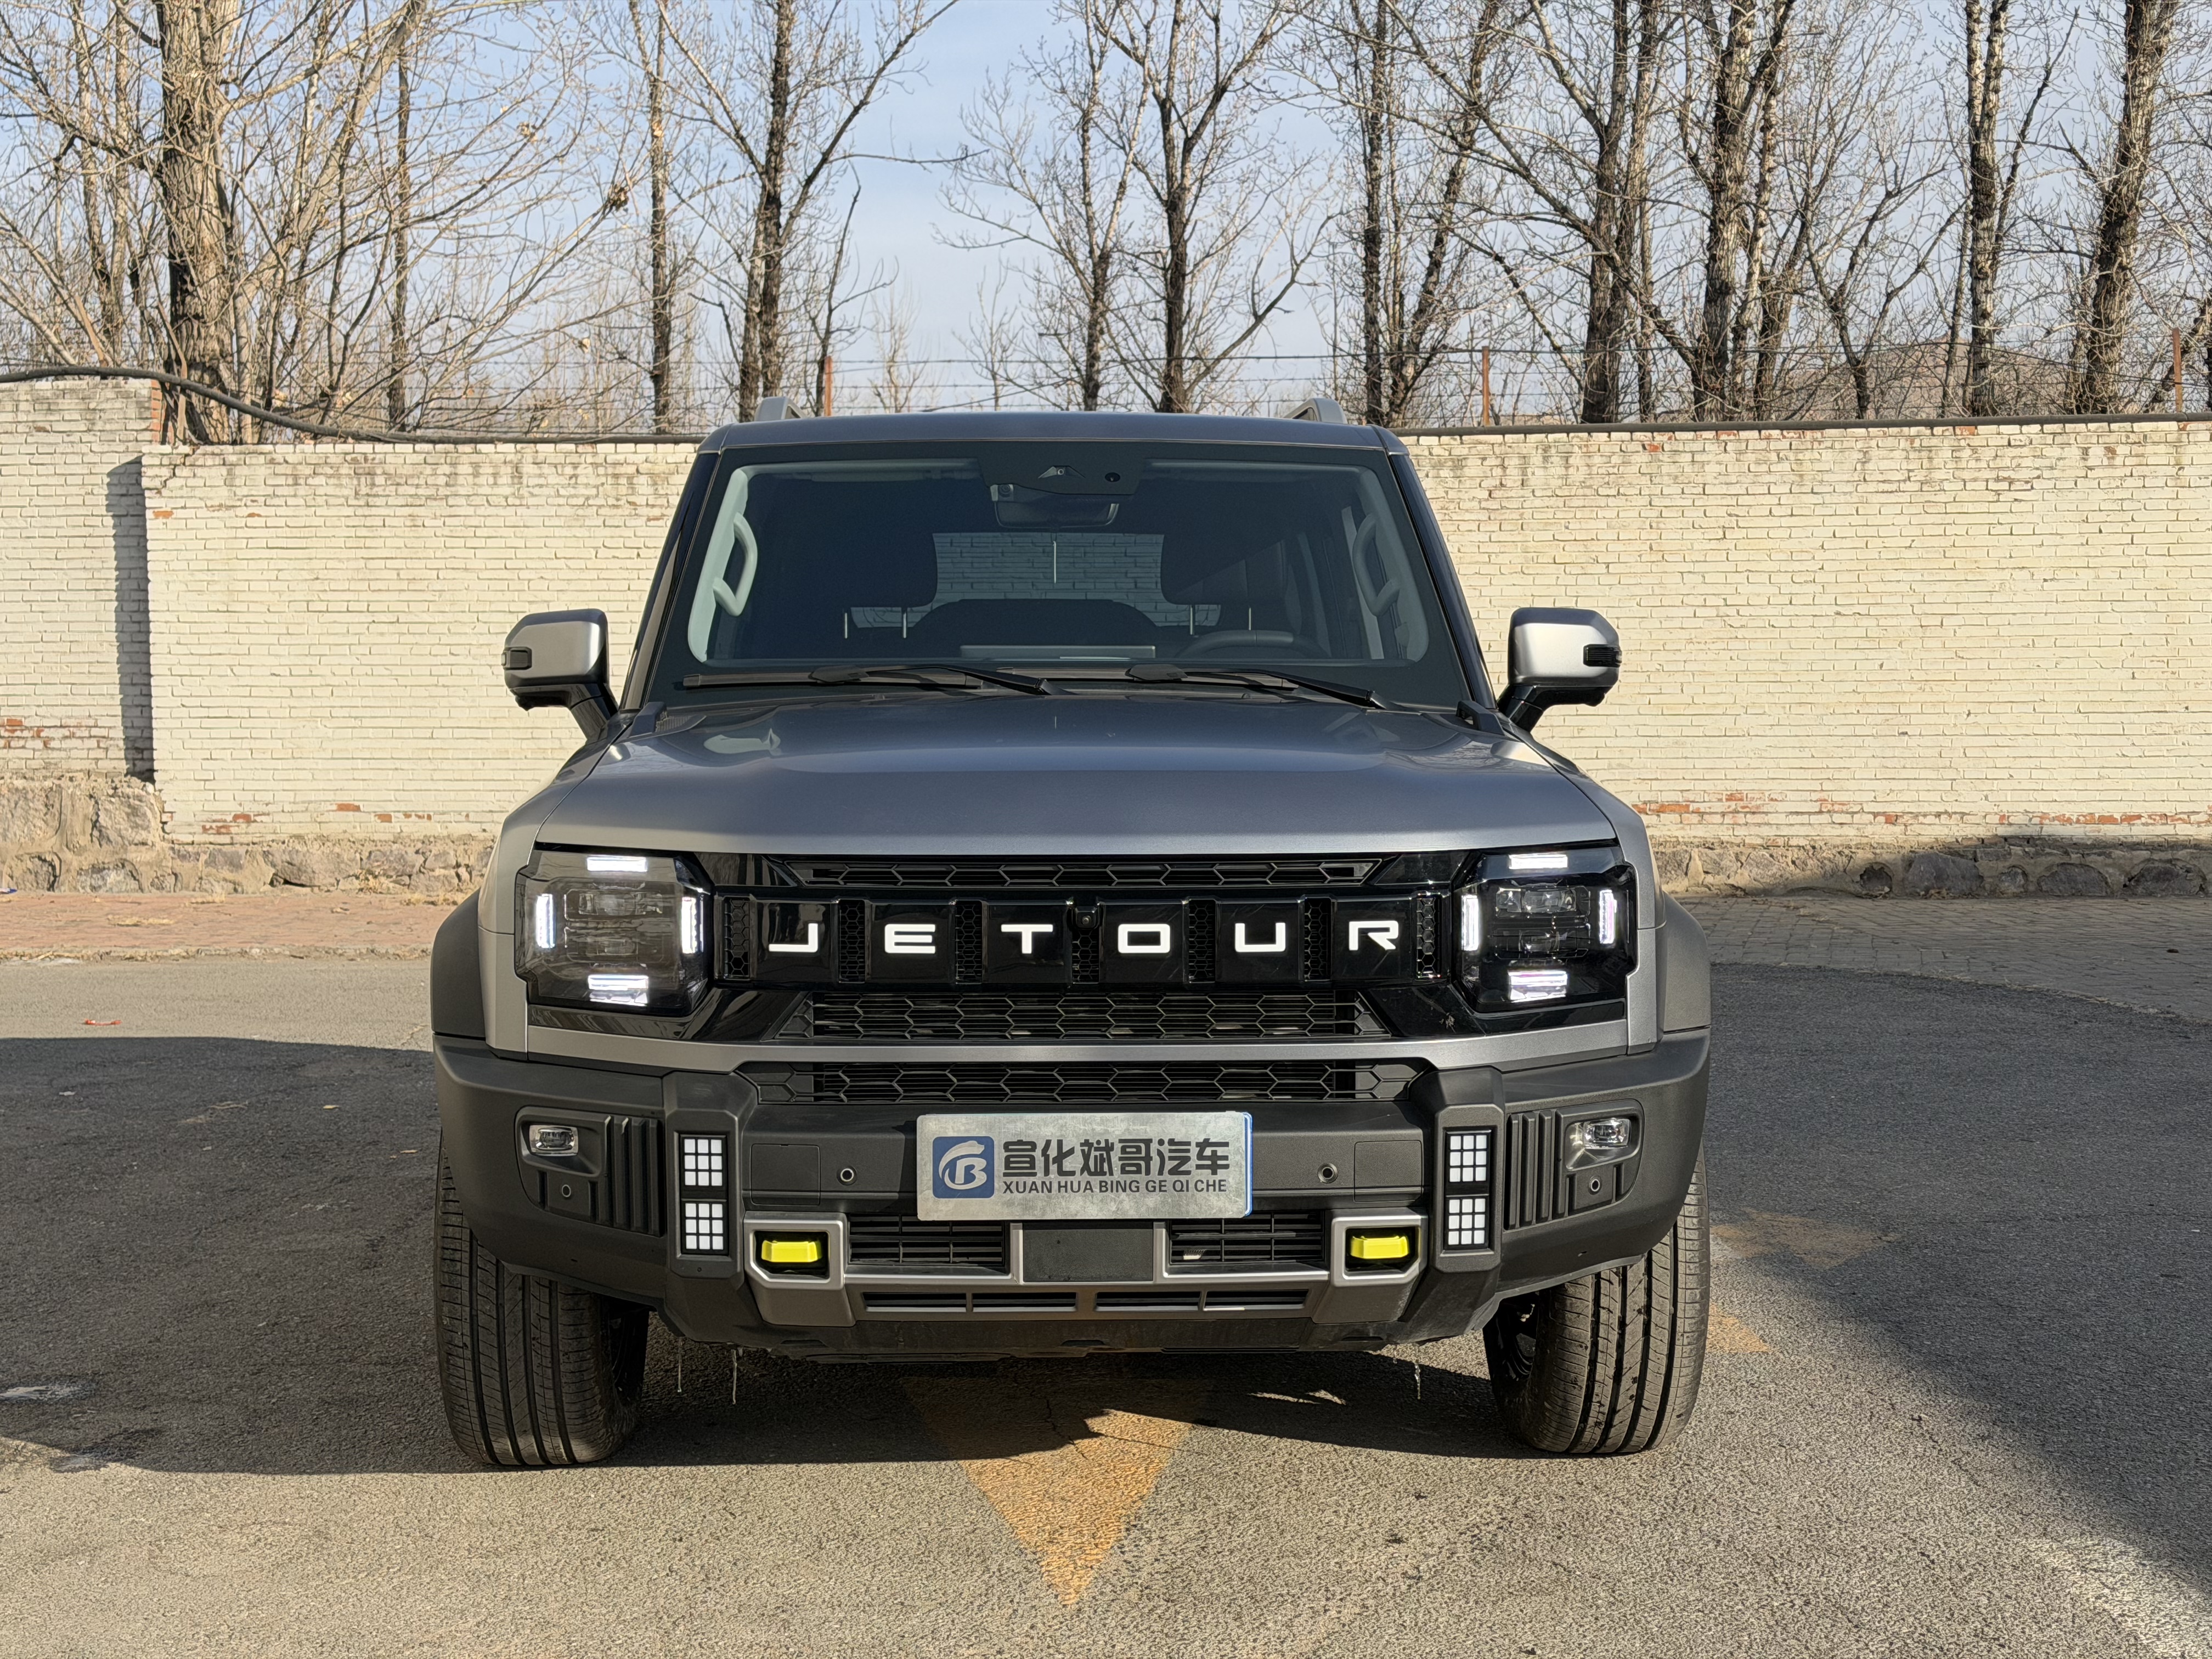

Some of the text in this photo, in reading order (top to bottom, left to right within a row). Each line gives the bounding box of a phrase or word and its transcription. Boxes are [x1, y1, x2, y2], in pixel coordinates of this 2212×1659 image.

[768, 920, 1400, 955] JETOUR
[1002, 1138, 1230, 1177] 宣化斌哥汽车
[1002, 1179, 1227, 1194] XUAN HUA BING GE QI CHE
